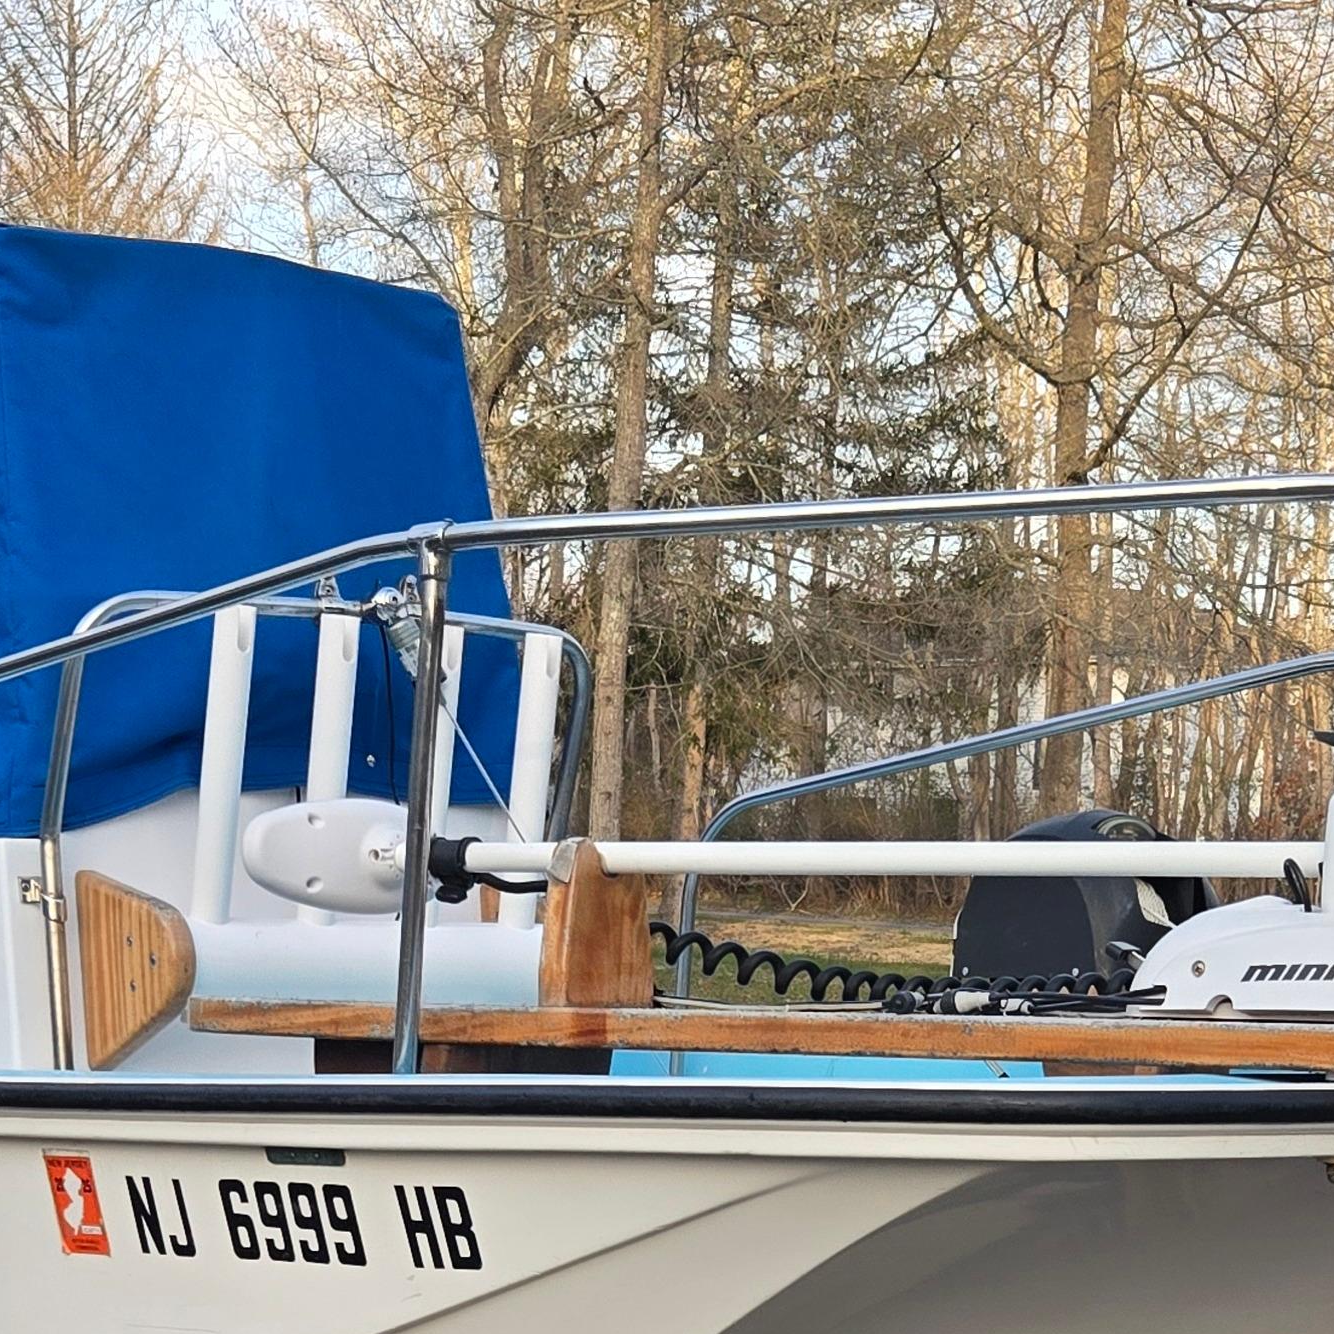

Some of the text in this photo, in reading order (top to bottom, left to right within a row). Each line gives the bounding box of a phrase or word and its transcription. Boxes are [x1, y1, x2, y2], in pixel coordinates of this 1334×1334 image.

[125, 1176, 482, 1270] NJ 6999 HB
